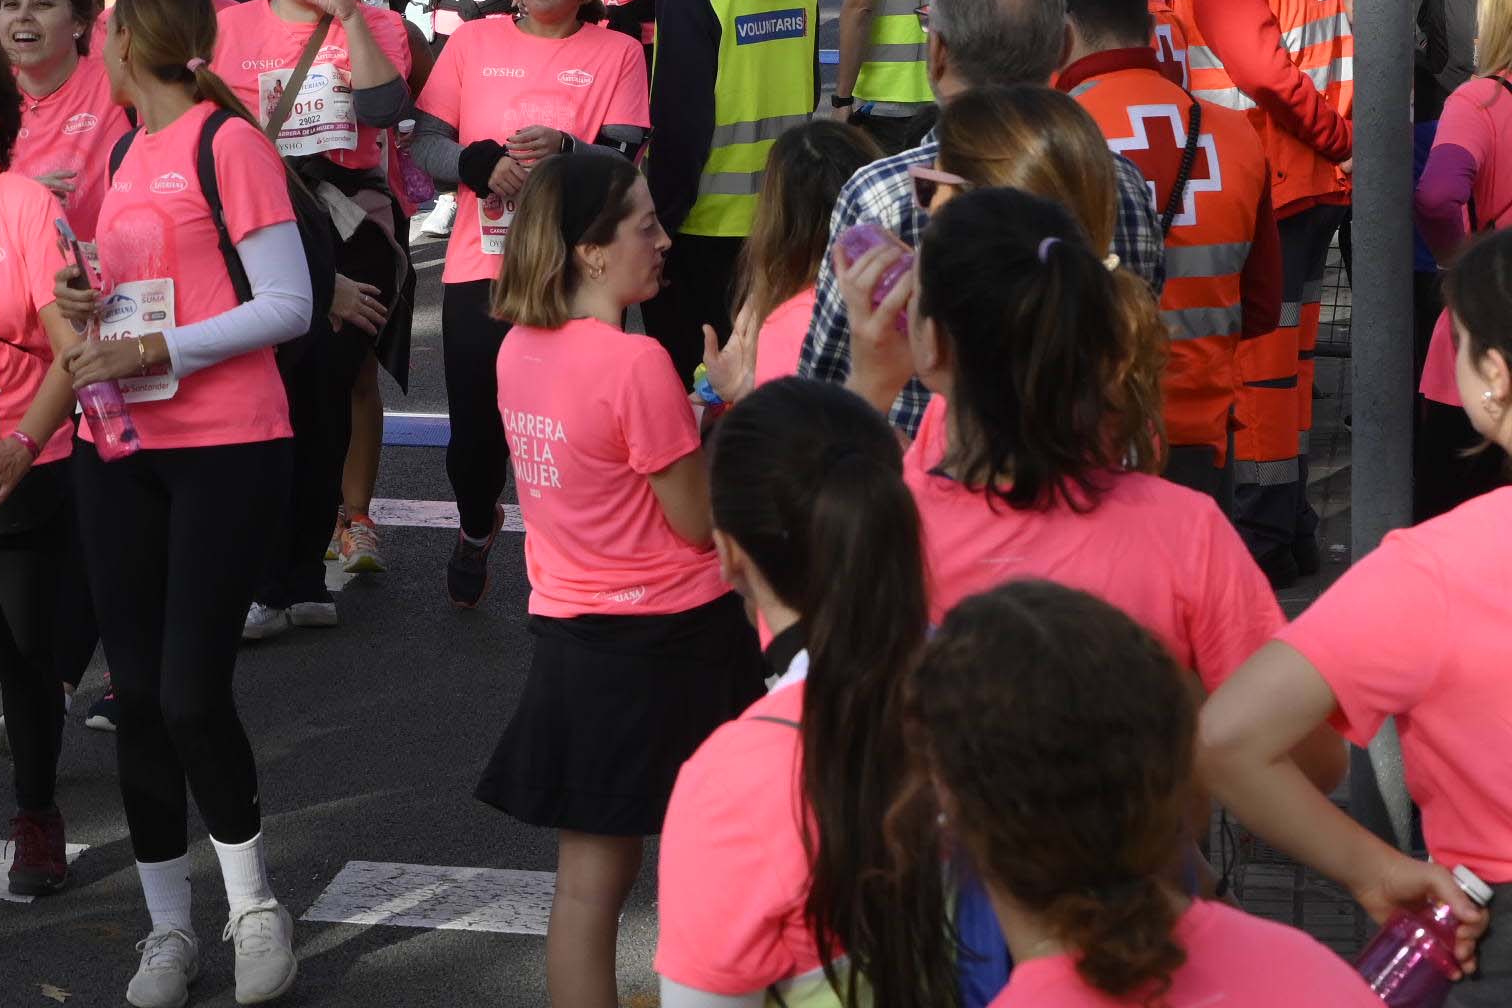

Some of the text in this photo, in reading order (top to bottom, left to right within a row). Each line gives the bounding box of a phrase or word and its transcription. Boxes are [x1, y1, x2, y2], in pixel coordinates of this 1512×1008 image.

[738, 15, 804, 38] VOLUNTARIS
[242, 58, 284, 70] OYSHO
[482, 67, 525, 78] OYSHO
[295, 98, 325, 115] 016
[279, 142, 303, 151] YSHO
[141, 295, 166, 304] SUMA
[504, 408, 568, 443] CARRERA
[512, 435, 555, 465] DE LA
[515, 461, 562, 489] MUJER
